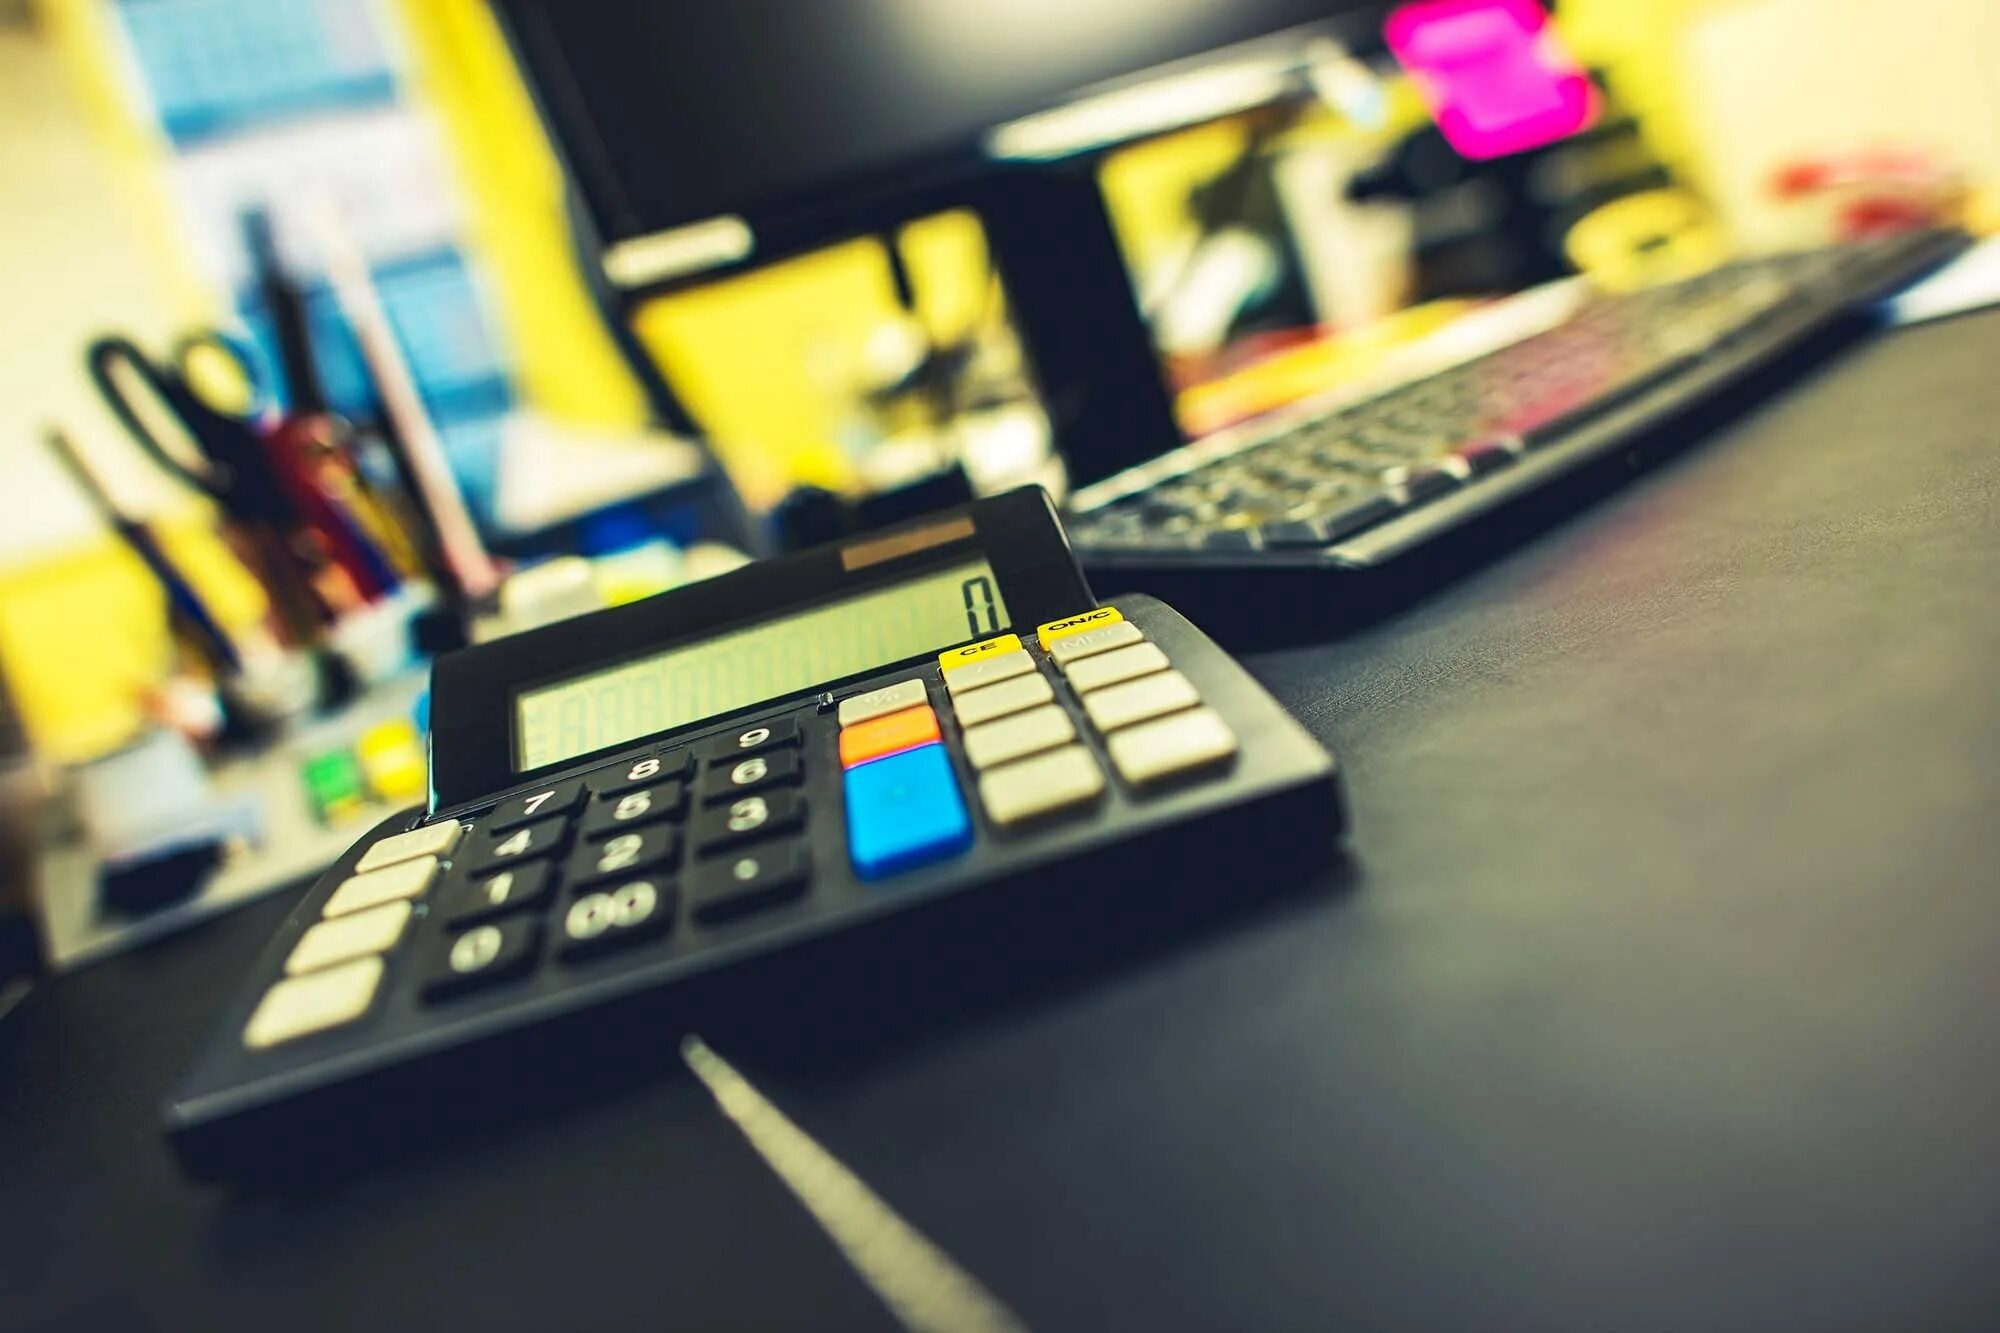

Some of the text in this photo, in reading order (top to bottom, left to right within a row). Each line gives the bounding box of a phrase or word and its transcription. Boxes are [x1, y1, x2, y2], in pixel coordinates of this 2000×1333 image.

[962, 576, 999, 638] 0
[1048, 610, 1111, 631] ON/C
[960, 642, 997, 656] CE
[739, 728, 770, 747] 9
[628, 759, 660, 780] 8
[731, 758, 768, 784] 6
[524, 791, 555, 815] 7
[614, 790, 652, 820] 5
[728, 797, 768, 831] 3
[494, 829, 531, 856] 4
[597, 834, 642, 872] 2
[484, 872, 513, 905] 1
[565, 881, 657, 939] 00
[449, 925, 502, 973] 0
